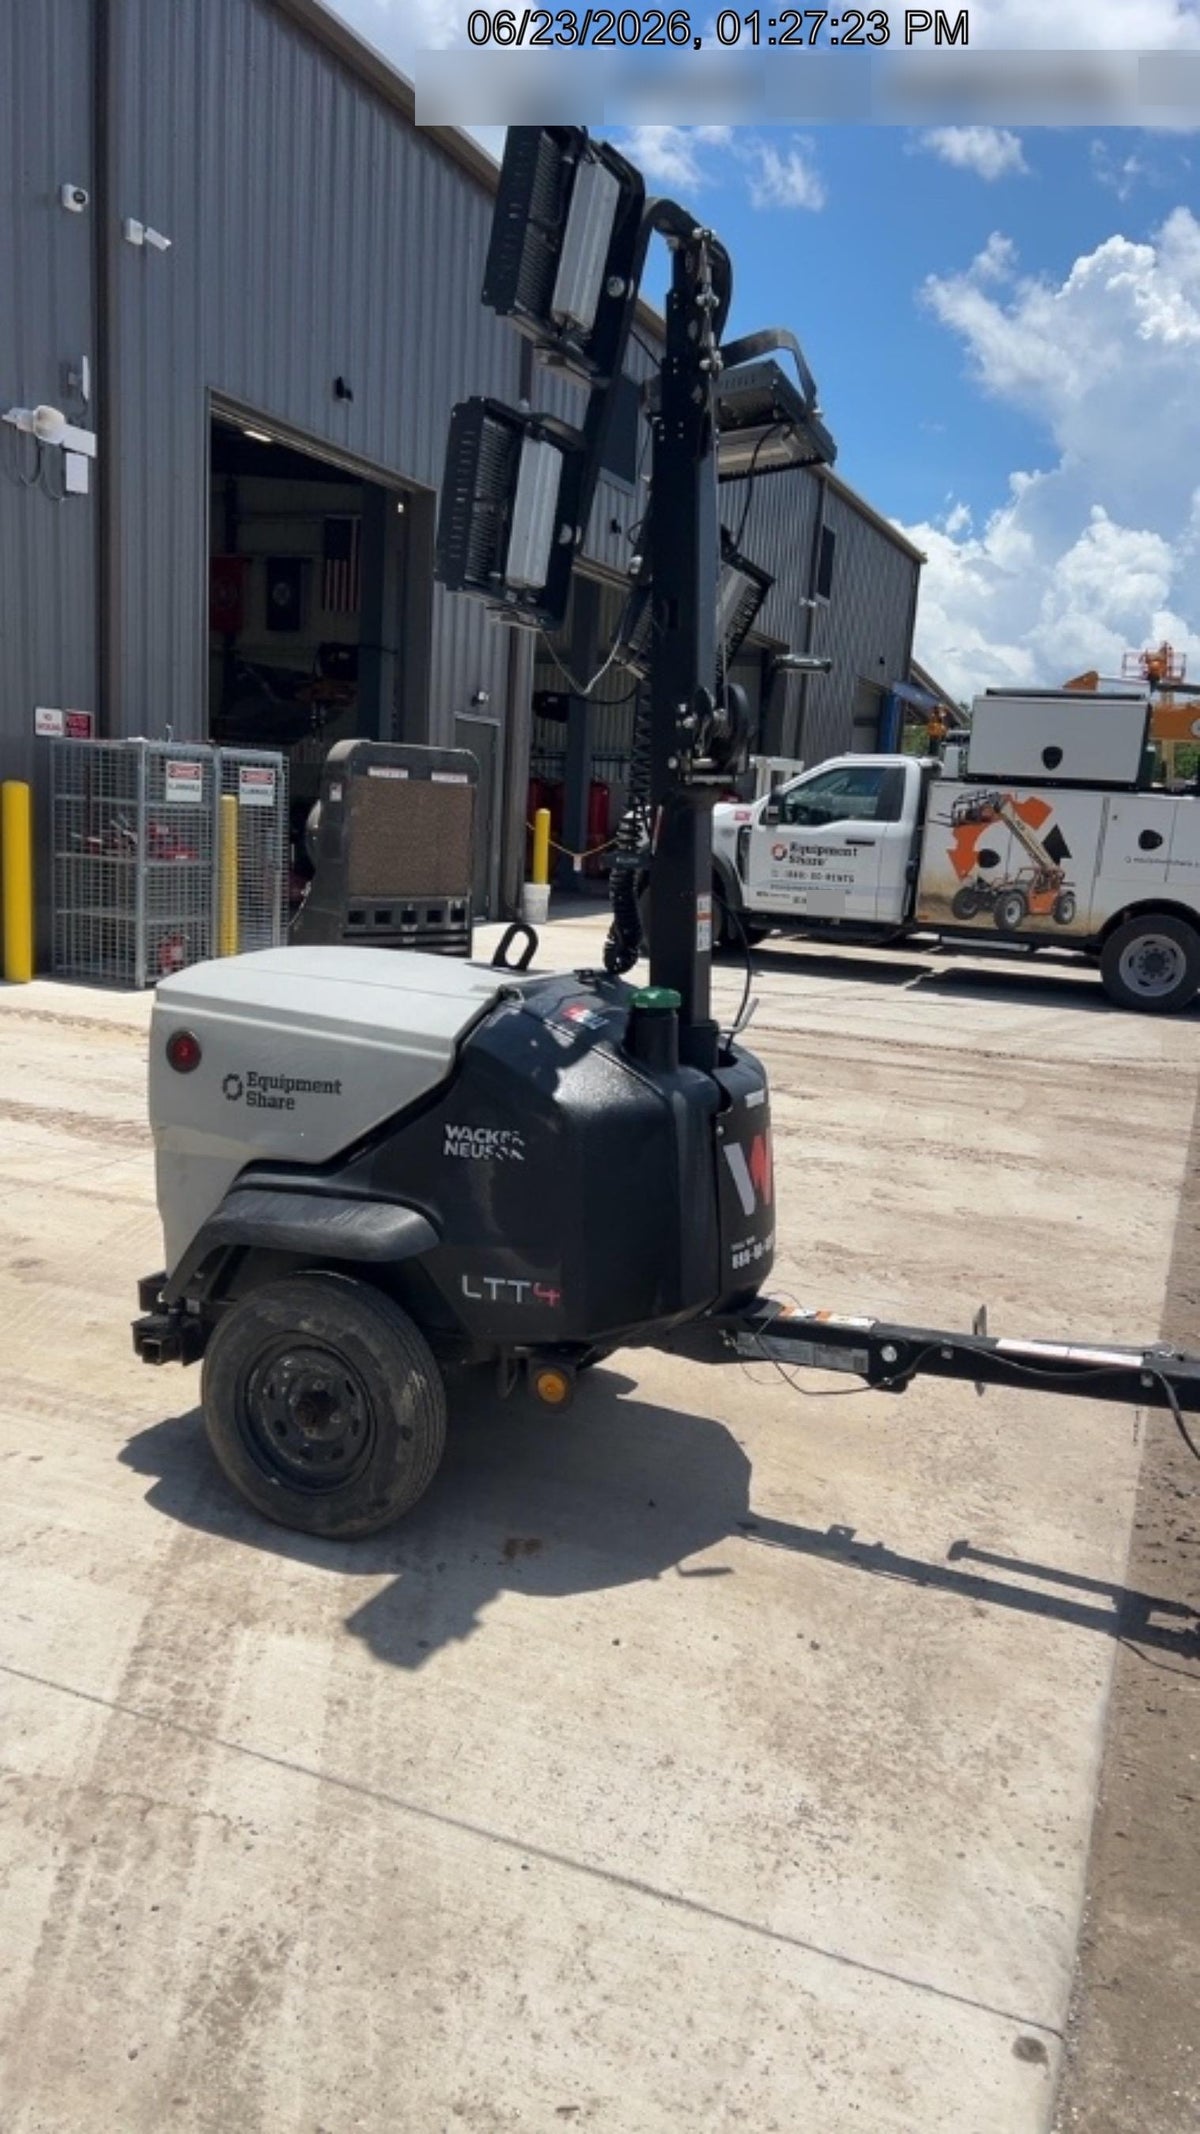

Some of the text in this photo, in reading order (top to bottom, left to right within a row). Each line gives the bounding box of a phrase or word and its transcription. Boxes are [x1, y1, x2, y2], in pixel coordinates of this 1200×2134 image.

[790, 841, 858, 857] Equipment
[246, 1071, 342, 1096] Equipment
[246, 1091, 296, 1110] Share
[461, 1274, 561, 1307] LTT4
